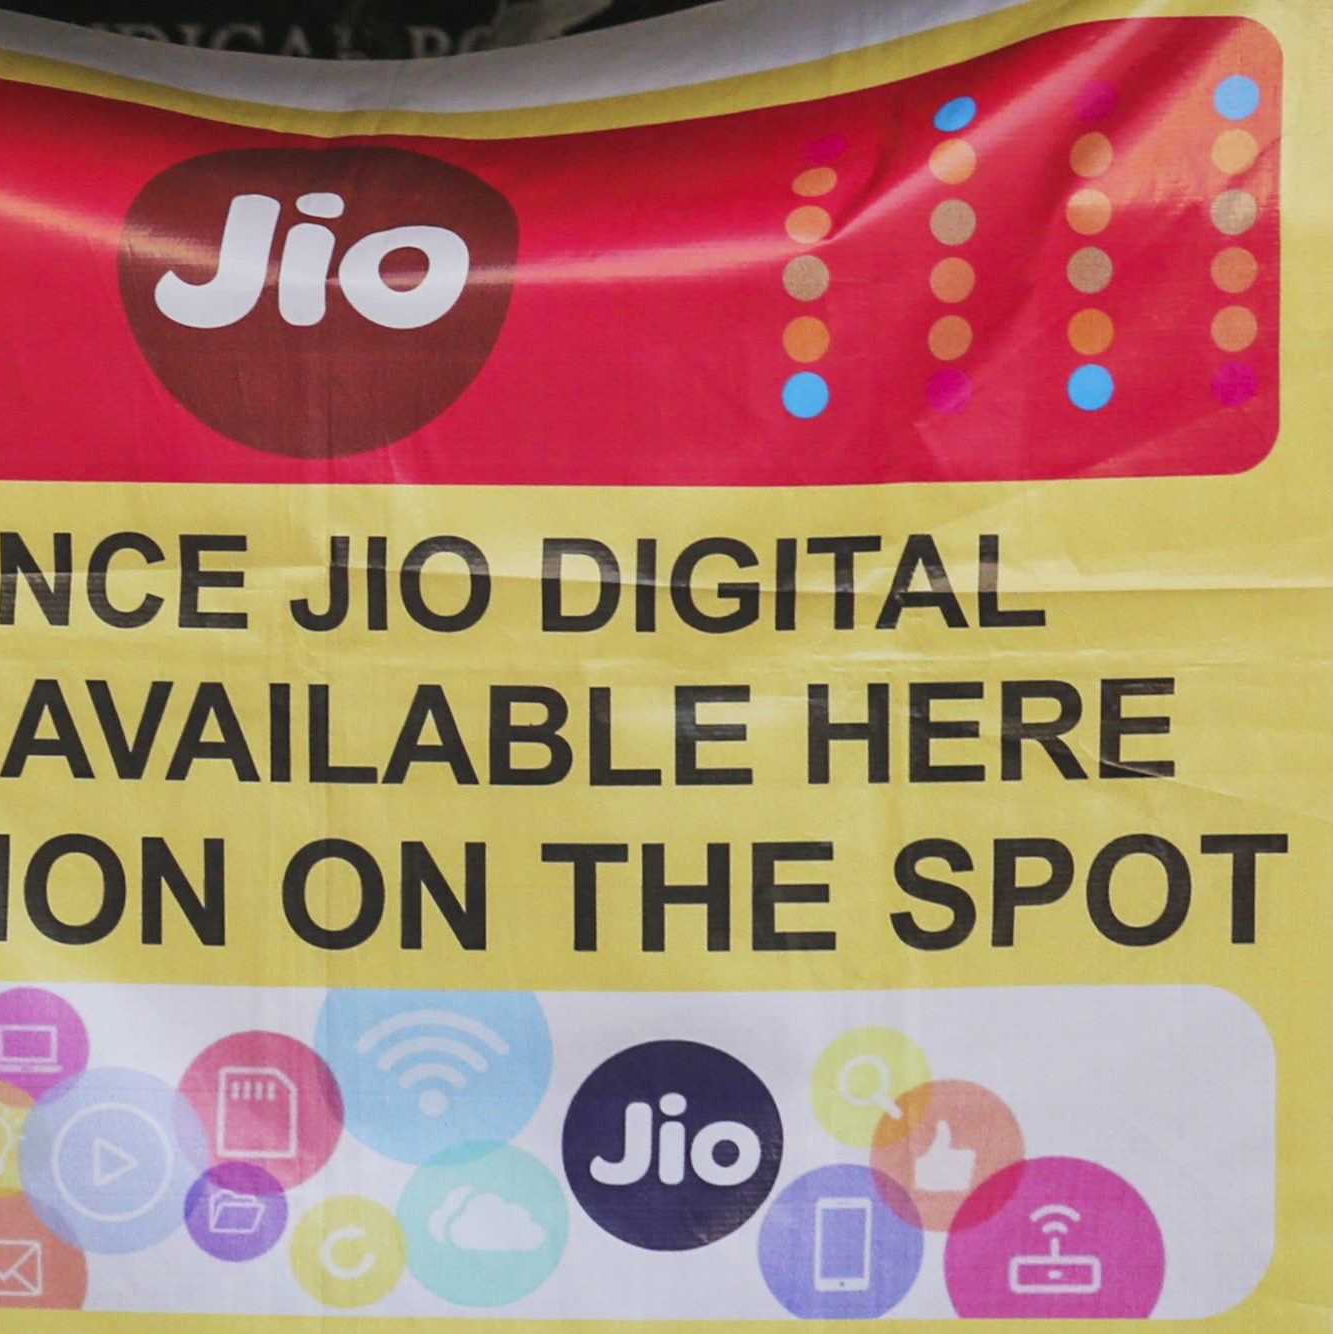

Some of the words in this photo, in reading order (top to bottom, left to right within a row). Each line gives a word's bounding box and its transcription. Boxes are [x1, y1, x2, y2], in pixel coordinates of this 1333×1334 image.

[155, 193, 469, 329] Jio
[290, 536, 491, 632] JIO
[542, 535, 1045, 633] DIGITAL
[0, 679, 752, 786] AVAILABLE
[808, 678, 1174, 784] HERE
[282, 839, 486, 950] ON
[541, 842, 836, 952] THE
[890, 834, 1288, 950] SPOT
[590, 1093, 761, 1185] Jio
